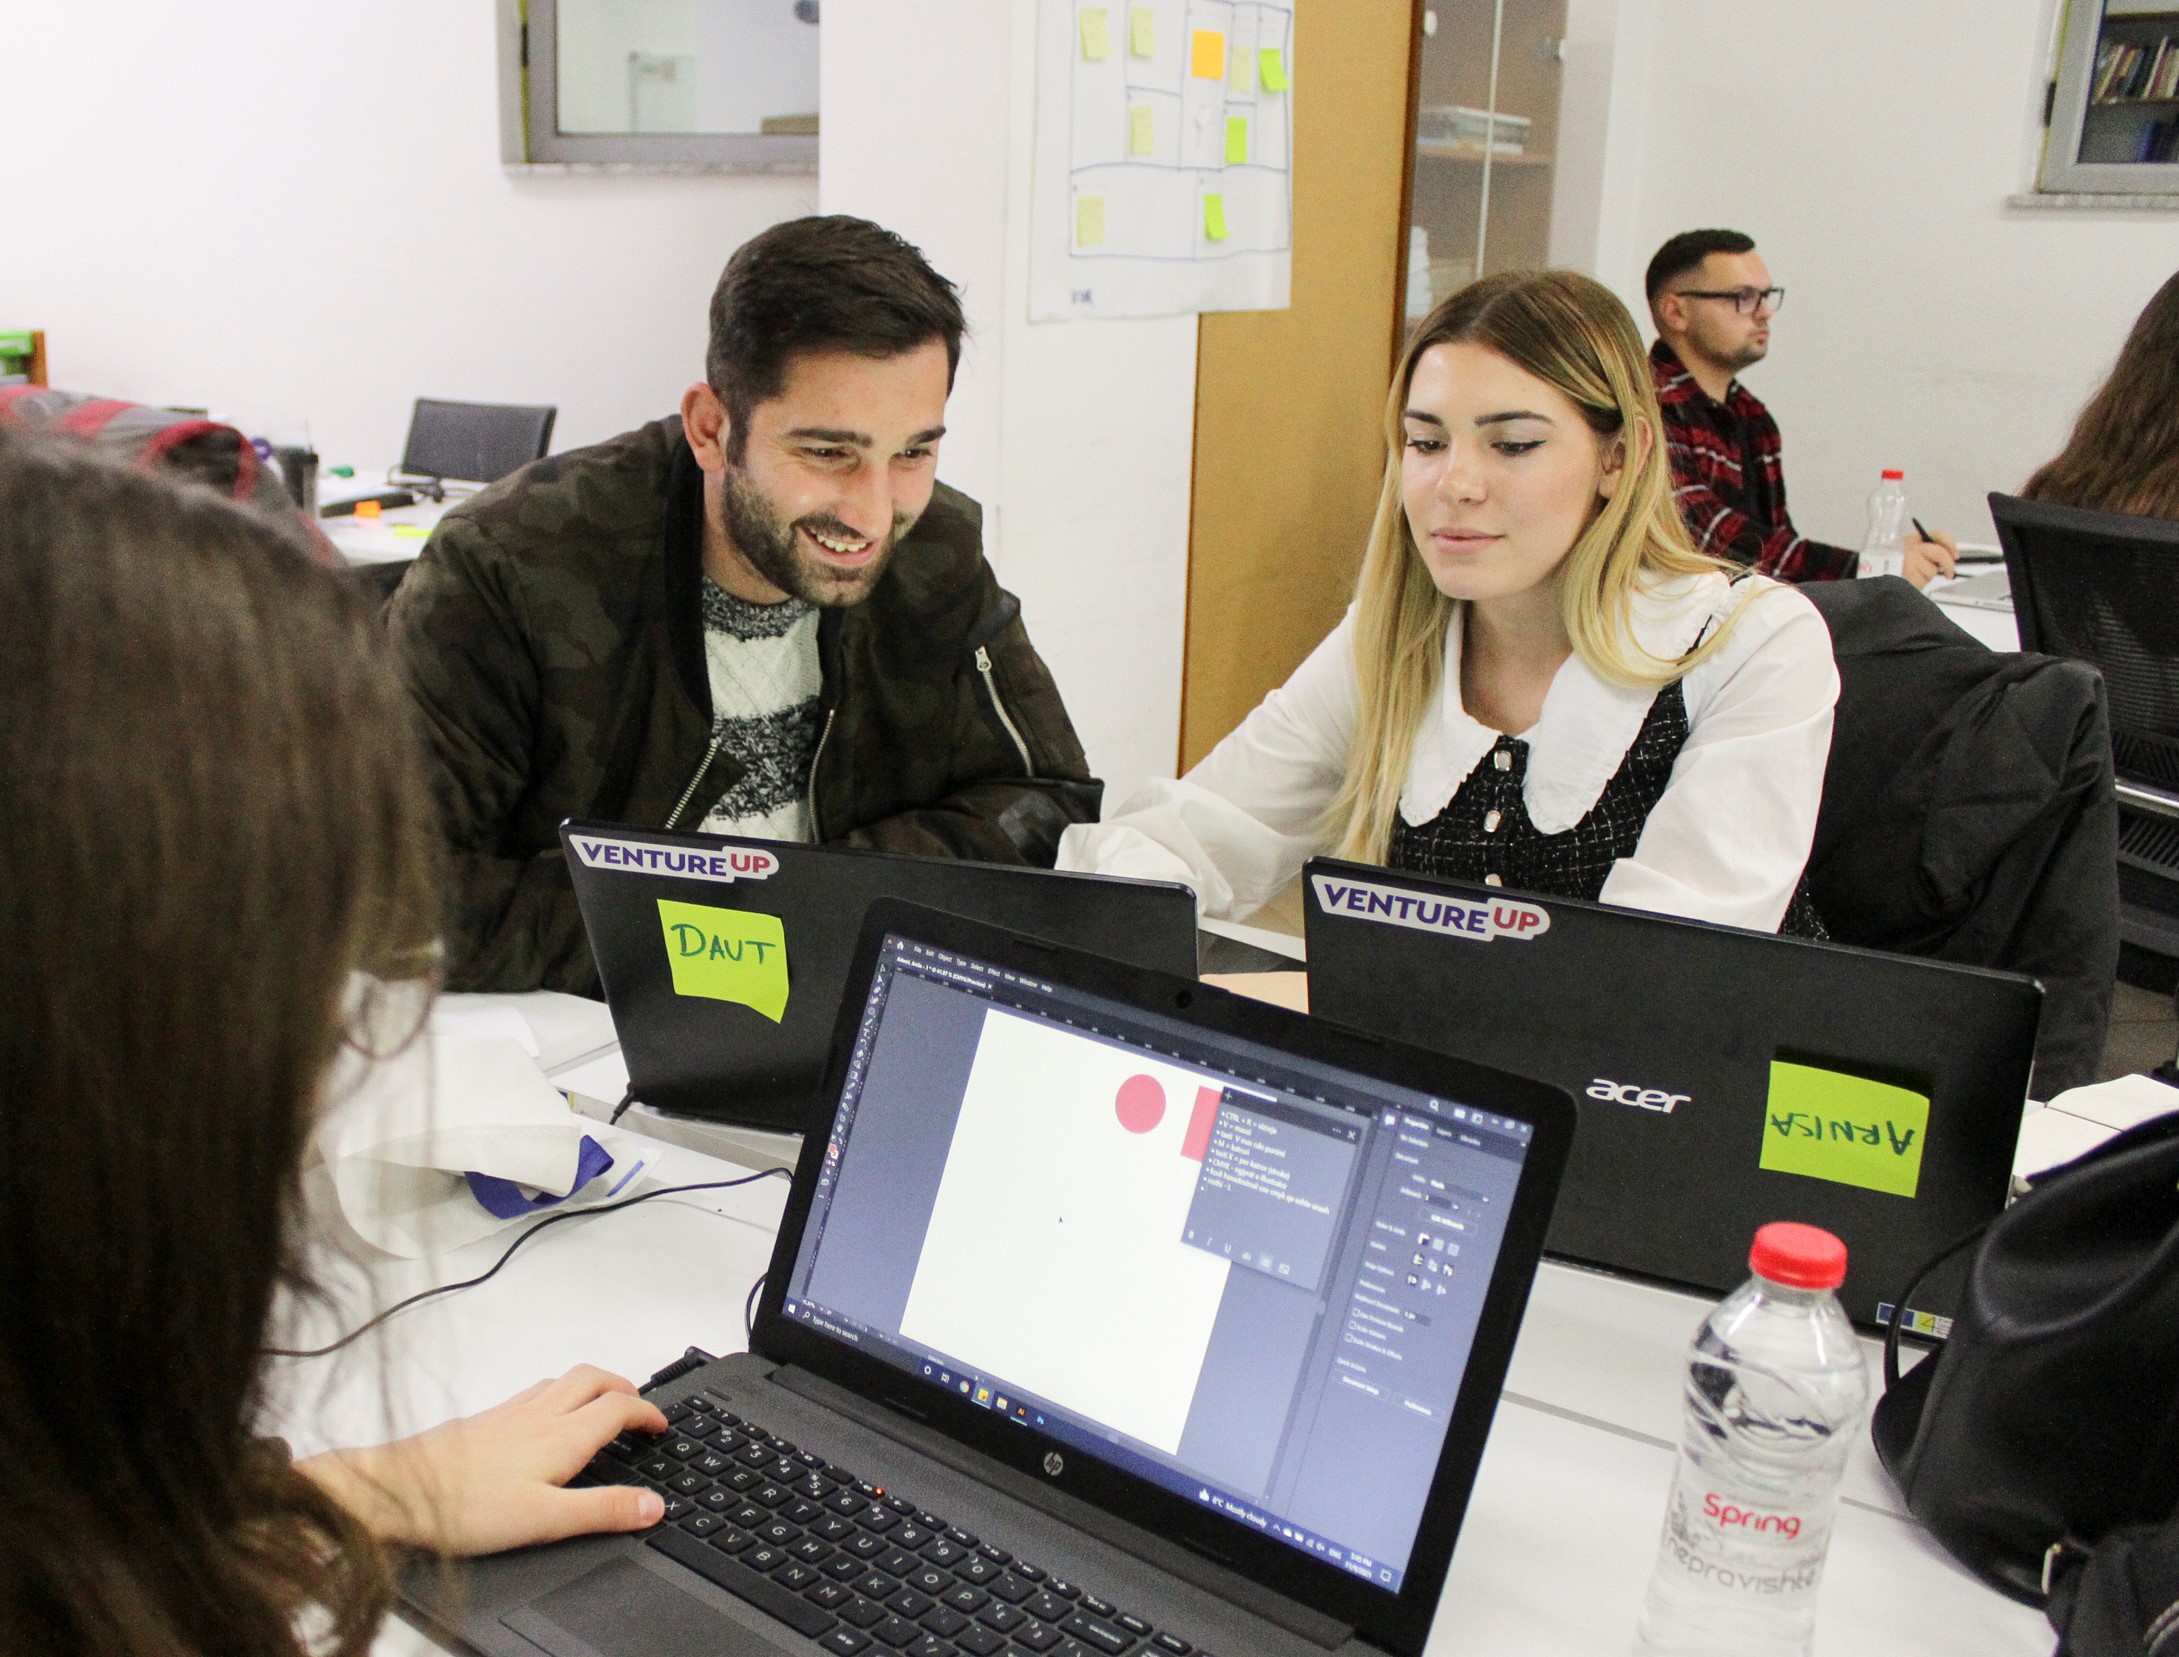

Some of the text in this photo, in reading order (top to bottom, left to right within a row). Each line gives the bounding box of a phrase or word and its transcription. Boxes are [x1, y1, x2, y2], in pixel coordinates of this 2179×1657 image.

[670, 923, 775, 964] DAUT
[938, 953, 952, 962] Object
[956, 958, 967, 966] Type
[970, 963, 984, 971] Select
[987, 968, 1000, 976] Effect
[1004, 973, 1015, 981] View
[1019, 977, 1037, 987] Window
[1041, 984, 1052, 992] Help
[1586, 1078, 1691, 1114] acer
[1771, 1112, 1915, 1156] ARNISA
[1212, 1159, 1230, 1169] CMYK
[812, 1316, 858, 1341] Type here to search
[677, 1443, 690, 1452] Q
[704, 1456, 721, 1467] W
[652, 1463, 665, 1471] A
[682, 1478, 695, 1486] S
[734, 1473, 748, 1482] E
[809, 1481, 821, 1489] 5
[710, 1492, 724, 1502] D
[762, 1488, 777, 1498] R
[665, 1501, 680, 1511] X
[840, 1497, 852, 1506] 6
[740, 1509, 755, 1518] F
[795, 1505, 808, 1515] T
[1225, 1502, 1245, 1518] Mostly
[1246, 1512, 1267, 1527] cloudy
[1703, 1493, 1801, 1541] Spring
[695, 1518, 710, 1528] C
[828, 1521, 842, 1531] Y
[771, 1526, 787, 1536] G
[727, 1533, 742, 1544] V
[858, 1538, 873, 1548] U
[802, 1542, 818, 1553] H
[756, 1552, 771, 1561] B
[836, 1562, 851, 1571] J
[788, 1569, 804, 1580] N
[868, 1578, 884, 1590] K
[820, 1586, 838, 1598] M
[958, 1592, 973, 1600] P
[902, 1597, 913, 1608] L
